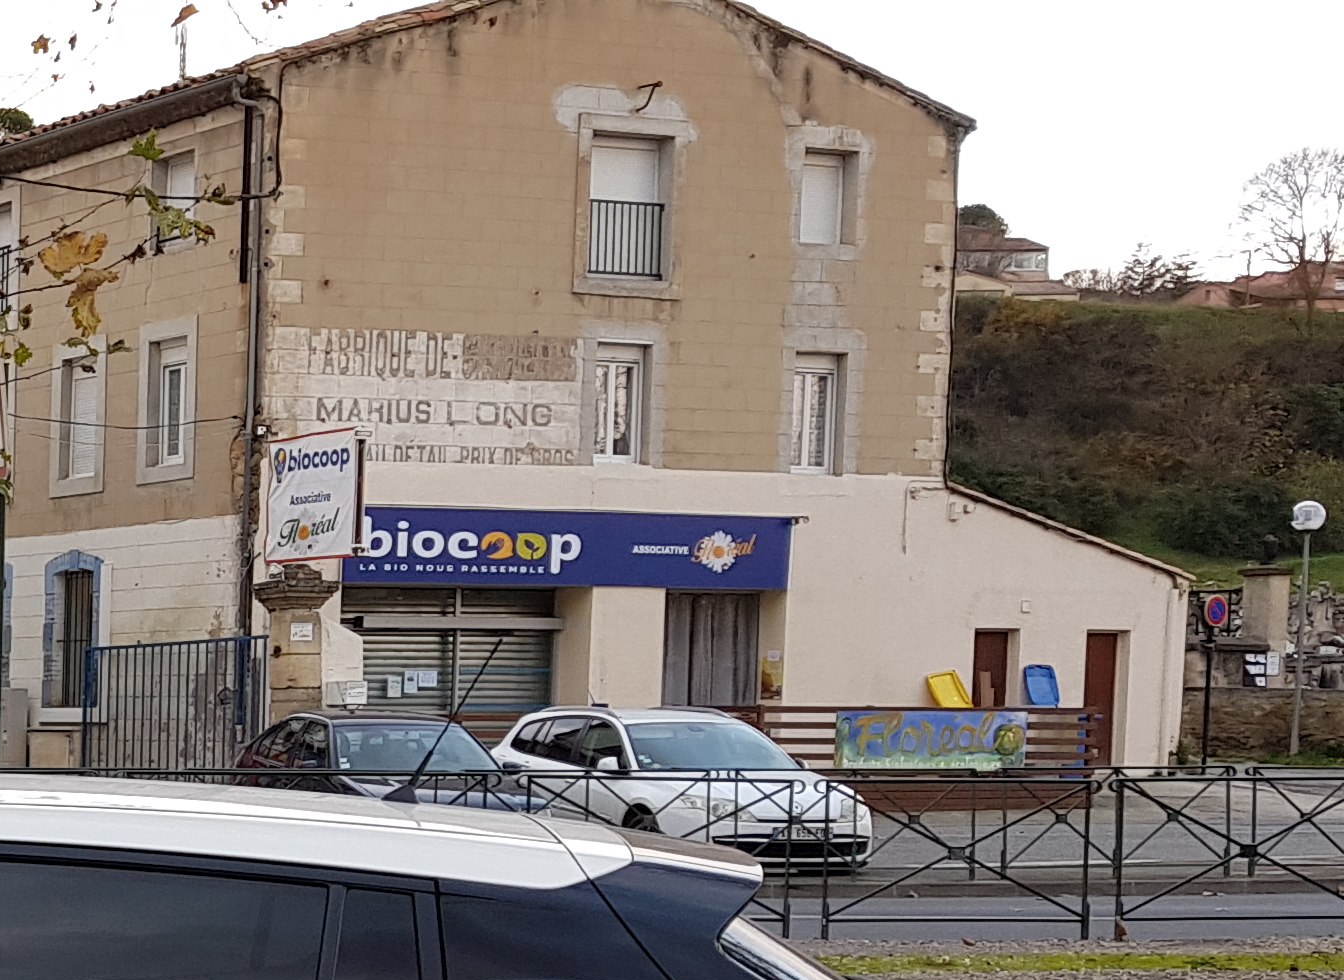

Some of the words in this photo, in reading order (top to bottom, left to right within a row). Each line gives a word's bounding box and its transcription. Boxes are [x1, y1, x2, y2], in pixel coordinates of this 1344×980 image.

[316, 396, 432, 424] MARIUS
[447, 401, 553, 428] LONG
[287, 447, 350, 472] biocoop
[290, 490, 331, 505] Associative
[364, 515, 582, 575] biocoop
[632, 545, 690, 555] ASSOCIATIVE
[359, 563, 377, 571] LA
[415, 564, 454, 572] NOUS
[460, 564, 546, 574] RASSEMBLE
